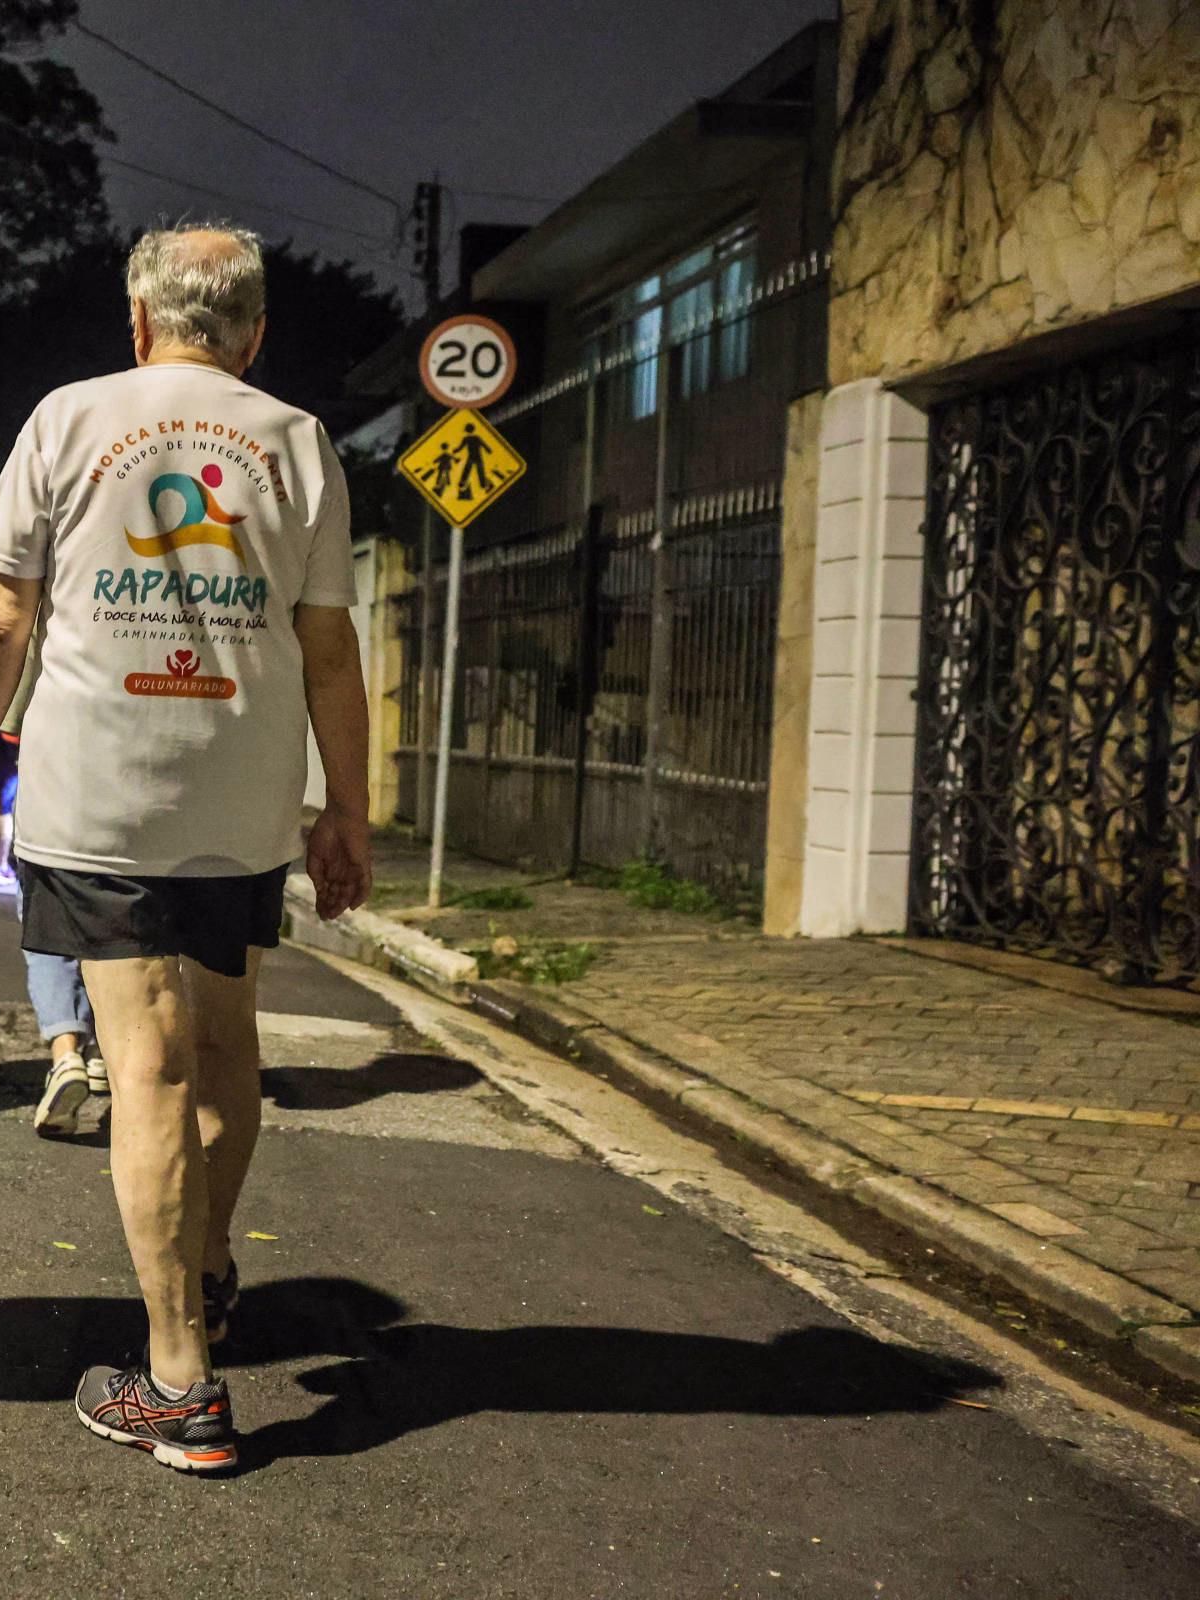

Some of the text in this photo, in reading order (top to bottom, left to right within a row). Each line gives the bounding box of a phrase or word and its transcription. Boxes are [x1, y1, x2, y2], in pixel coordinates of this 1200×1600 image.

[436, 341, 501, 378] 20
[89, 420, 287, 502] MOOCA EM MOVIMENTO
[116, 440, 269, 494] GRUPO DE INTEGRAÇÃO
[93, 568, 268, 613] RAPADURA
[93, 606, 268, 629] É DOCE MAS NÃO É MOLE NÃO
[113, 629, 194, 641] CAMINHADA
[212, 634, 253, 646] PEDAL
[134, 679, 227, 693] VOLUNTARIADO
